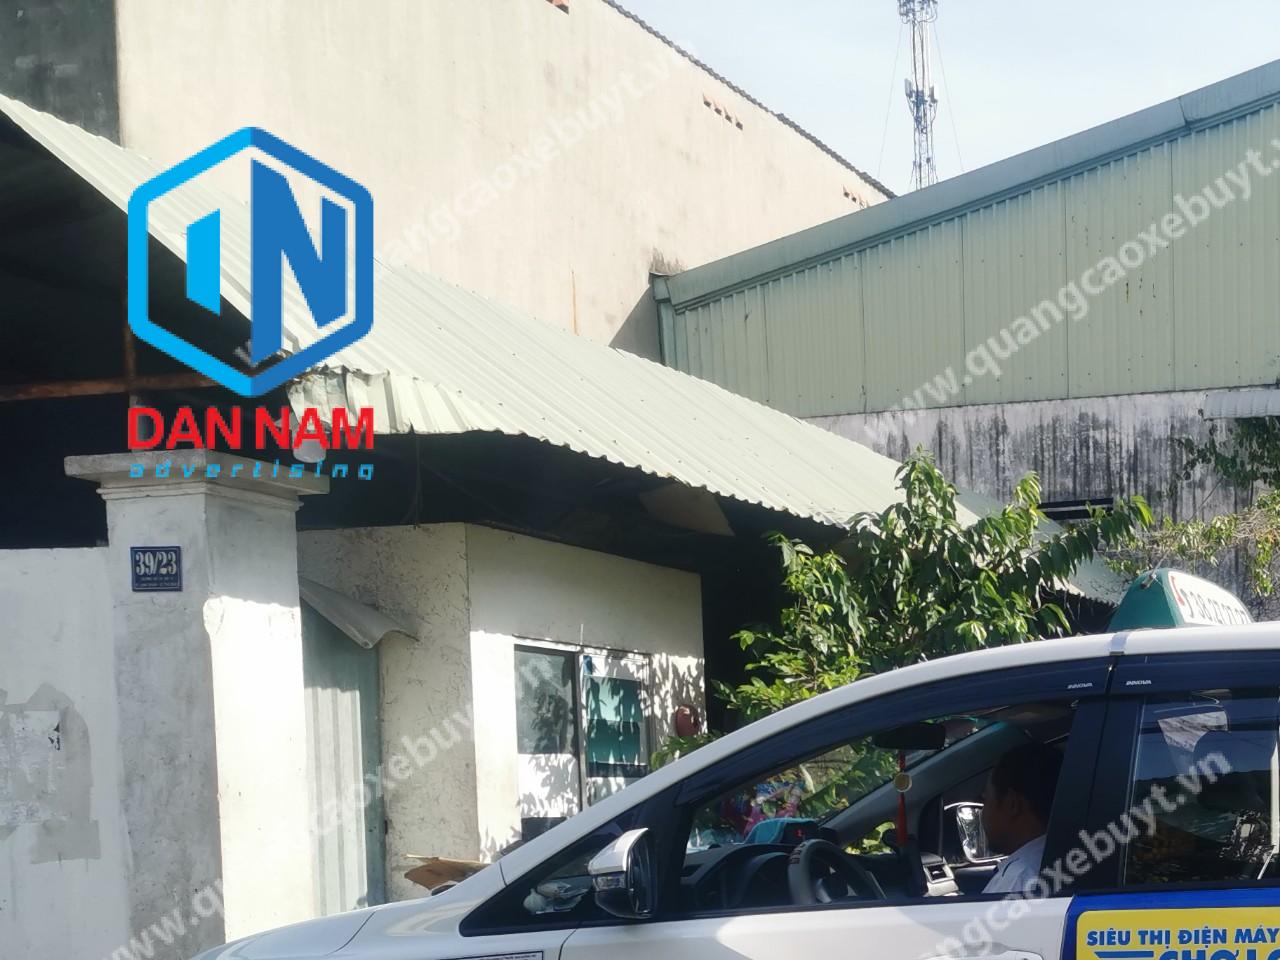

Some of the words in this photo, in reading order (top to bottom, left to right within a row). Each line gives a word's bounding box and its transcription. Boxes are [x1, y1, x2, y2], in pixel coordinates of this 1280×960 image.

[136, 551, 177, 576] 39/23
[1086, 927, 1131, 946] SIÊU
[1137, 929, 1171, 949] THỊ
[1177, 926, 1227, 949] ĐIỆN
